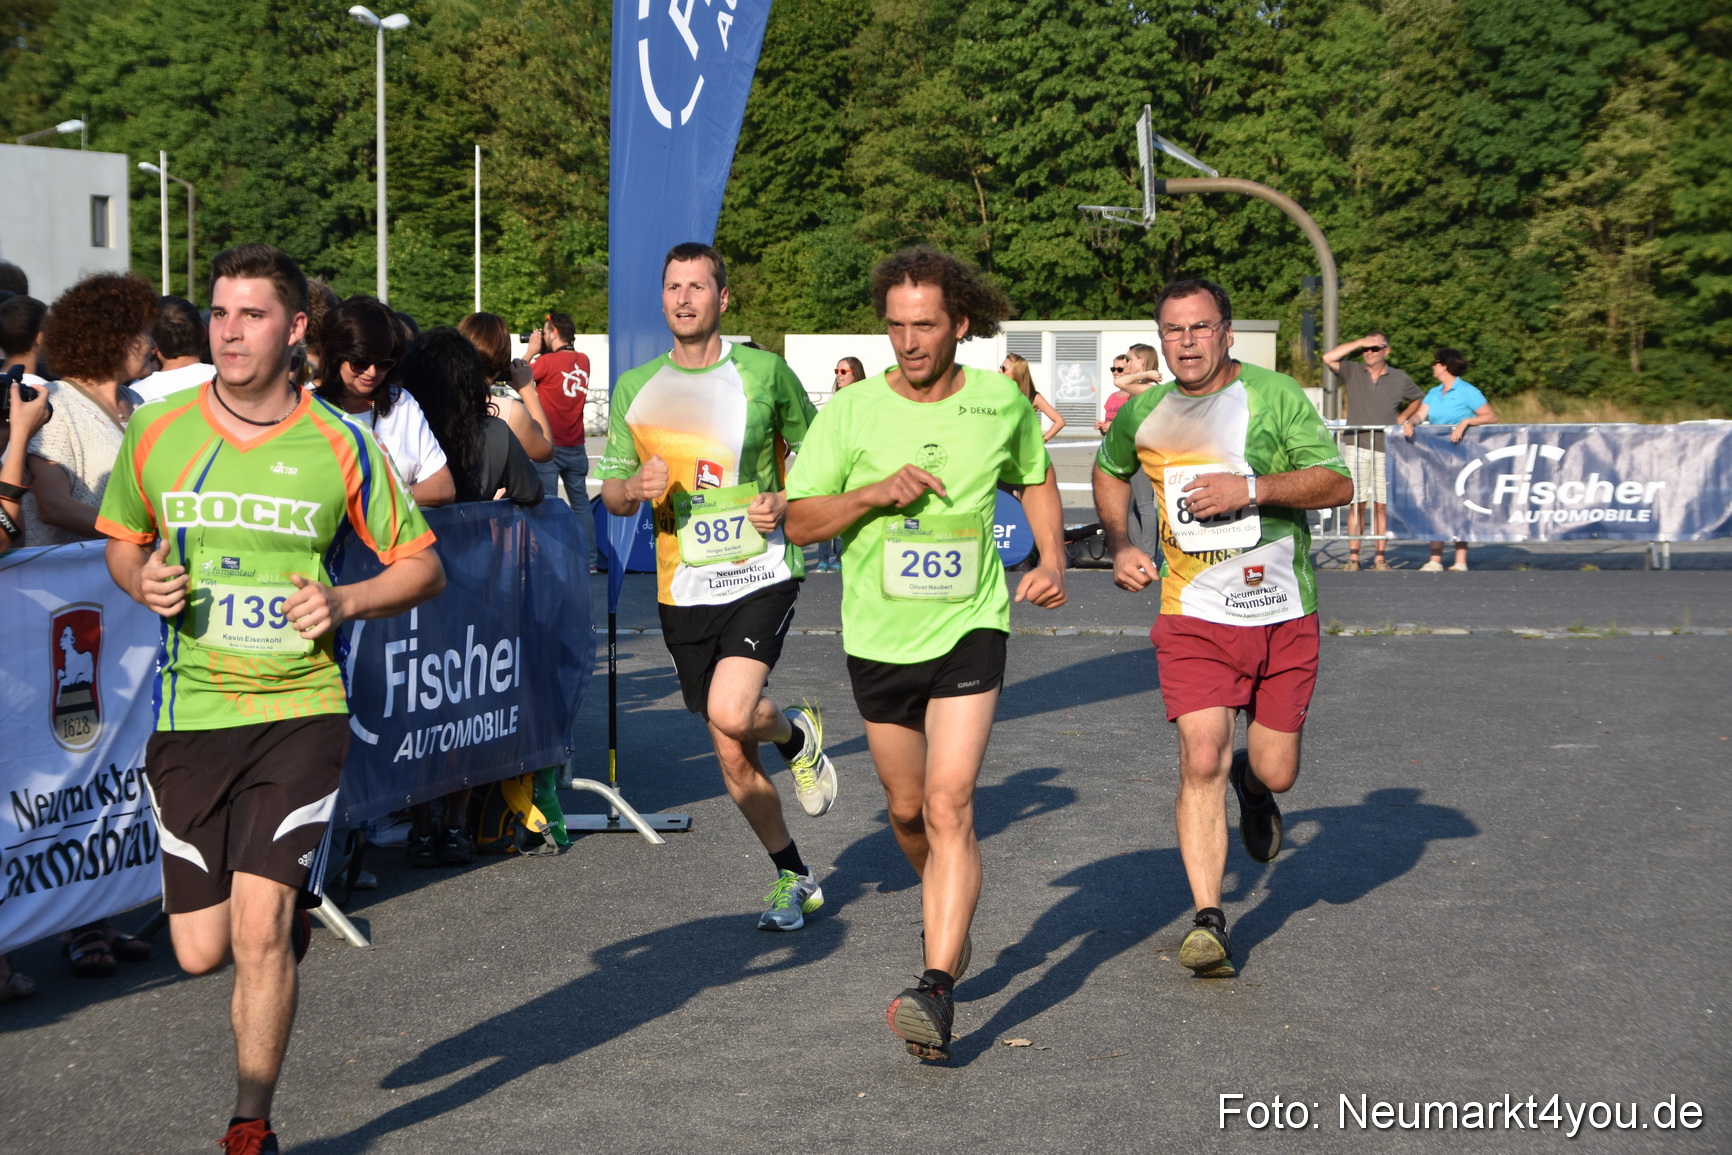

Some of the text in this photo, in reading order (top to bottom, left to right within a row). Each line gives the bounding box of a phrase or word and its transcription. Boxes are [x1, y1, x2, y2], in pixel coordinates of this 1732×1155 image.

[970, 407, 997, 416] DEKRA
[1492, 472, 1666, 505] Fischer
[162, 491, 321, 537] BOCK
[1507, 508, 1651, 523] AUTOMOBILE
[694, 515, 745, 544] 987
[1174, 524, 1257, 537] www.df-sports.de
[212, 566, 256, 578] firmenlauf
[716, 564, 766, 578] Neumarkter
[900, 549, 962, 578] 263
[709, 570, 775, 589] Lammsbräu
[1225, 593, 1288, 609] Lammsbräu
[1230, 585, 1278, 601] Neumarkter
[218, 593, 289, 630] 139
[222, 633, 282, 644] Kevin Eisenkohl
[957, 680, 980, 689] CRAFT
[63, 716, 91, 738] 1628
[393, 704, 519, 763] AUTOMOBILE
[0, 808, 158, 900] ammsbräu
